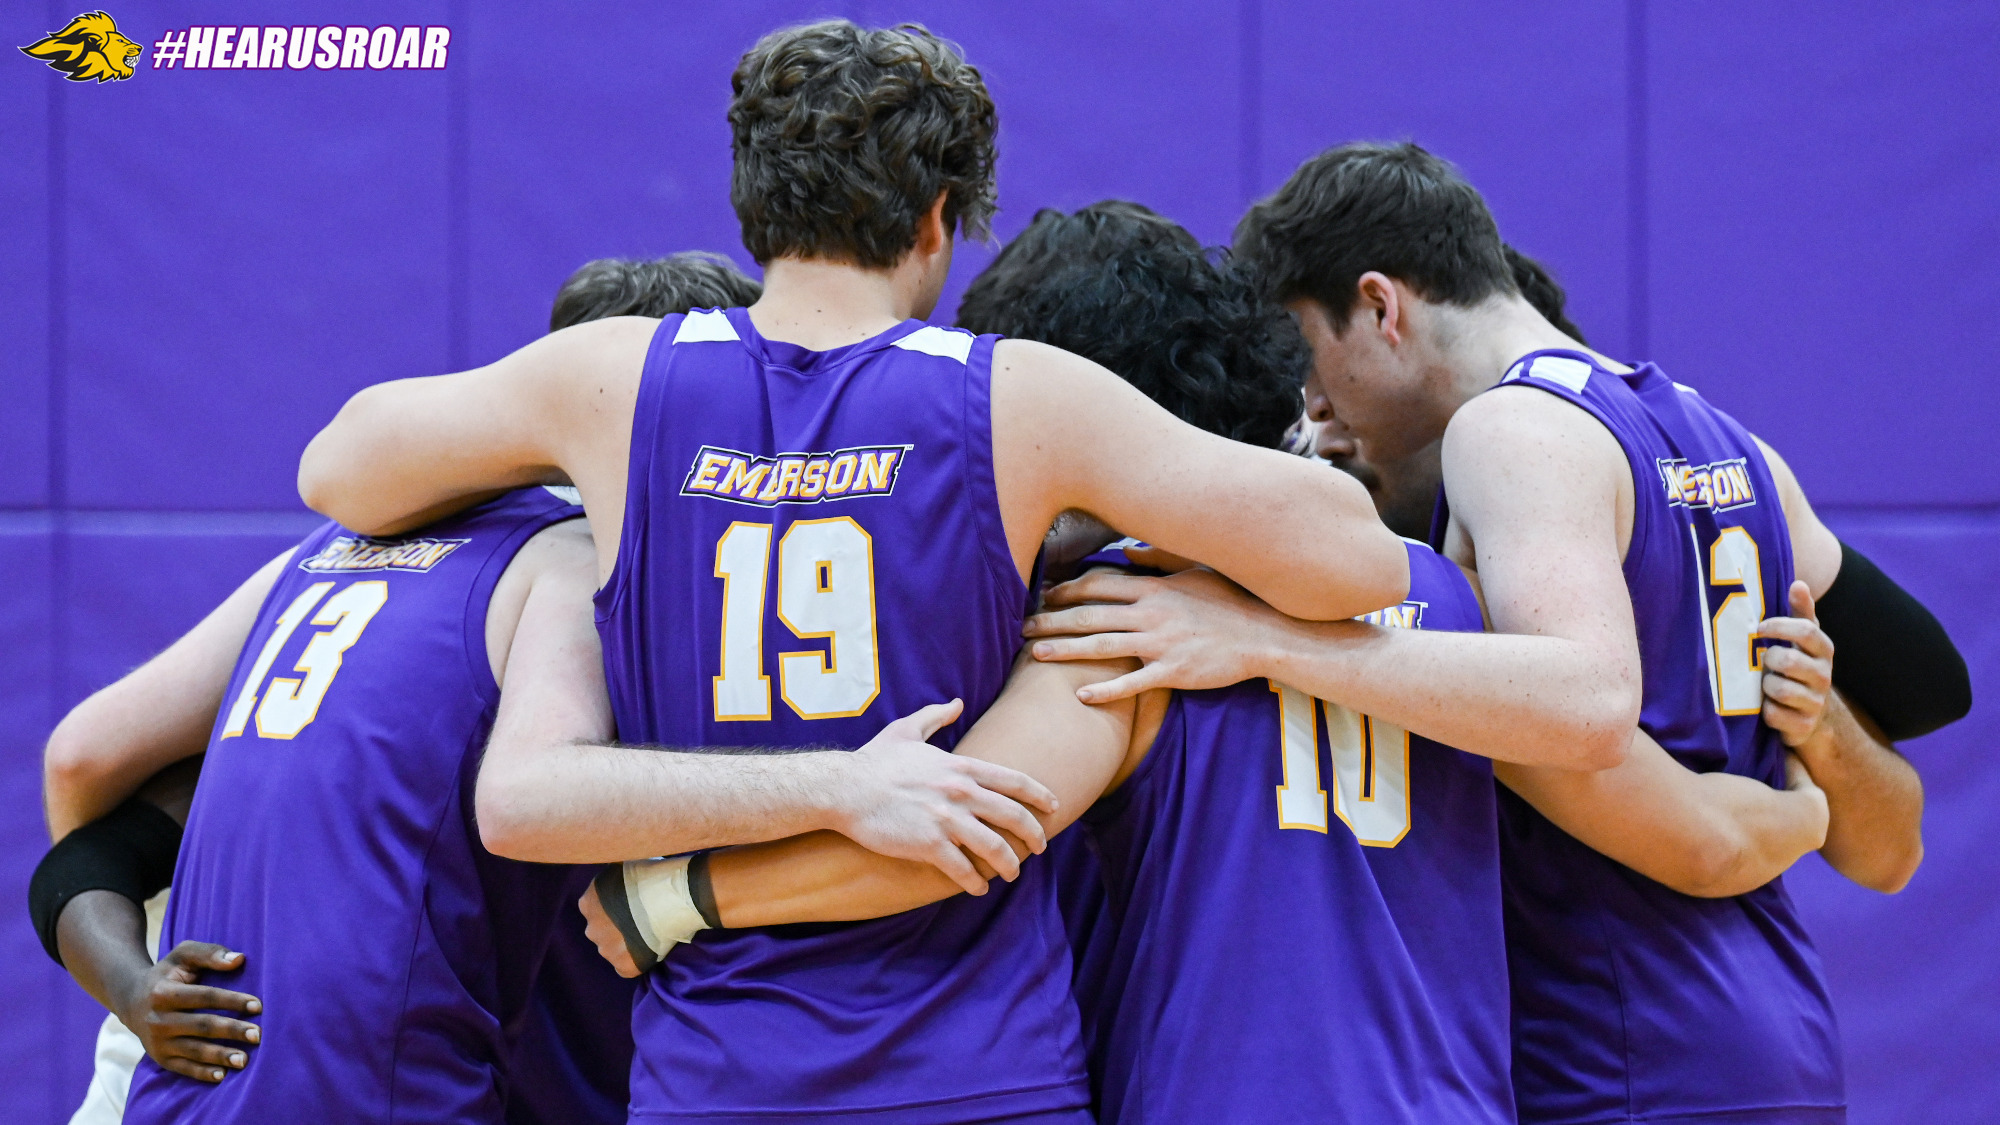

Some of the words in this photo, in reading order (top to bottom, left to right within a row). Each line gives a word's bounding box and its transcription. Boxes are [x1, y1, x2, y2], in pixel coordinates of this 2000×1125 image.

[221, 580, 389, 742] 13
[713, 516, 881, 722] 19
[1690, 523, 1766, 718] 2
[1268, 677, 1412, 849] 10
